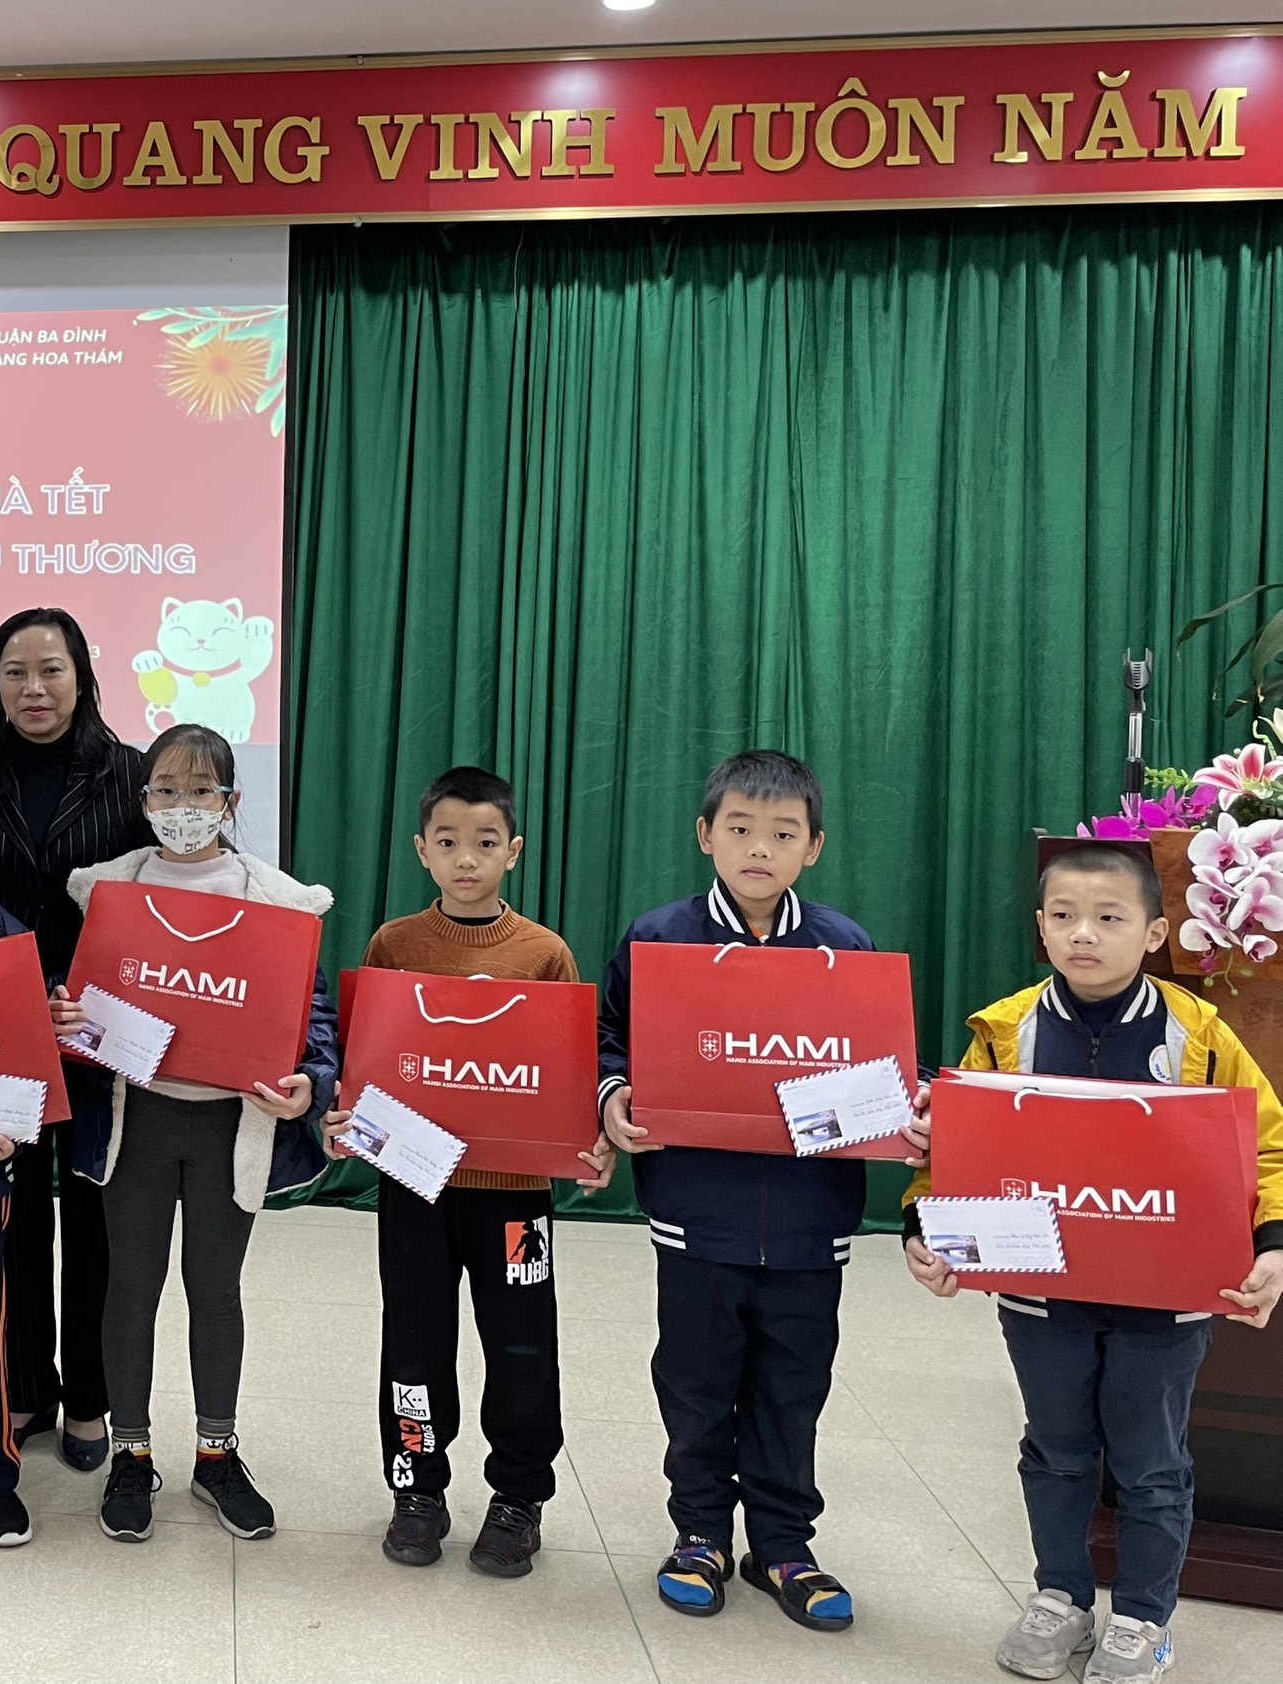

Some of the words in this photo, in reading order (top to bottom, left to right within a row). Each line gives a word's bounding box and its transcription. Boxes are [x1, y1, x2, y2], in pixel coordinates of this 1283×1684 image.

[357, 107, 617, 182] VINH
[654, 77, 966, 174] MUÔN
[992, 70, 1247, 164] NĂM
[37, 330, 58, 343] BA
[63, 326, 107, 343] ĐÌNH
[32, 352, 69, 366] HOA
[74, 348, 123, 365] THÁM
[41, 466, 111, 515] TẾT
[11, 540, 197, 575] THƯƠNG
[138, 961, 248, 1001] HAMI
[725, 1032, 851, 1061] HAMI
[422, 1056, 539, 1087] HAMI
[747, 1058, 788, 1066] ASSOCIATION
[1030, 1181, 1176, 1214] HAMI
[1057, 1209, 1103, 1219] ASSOCIATION
[506, 1257, 549, 1285] PUBG
[398, 1406, 427, 1417] CHINA
